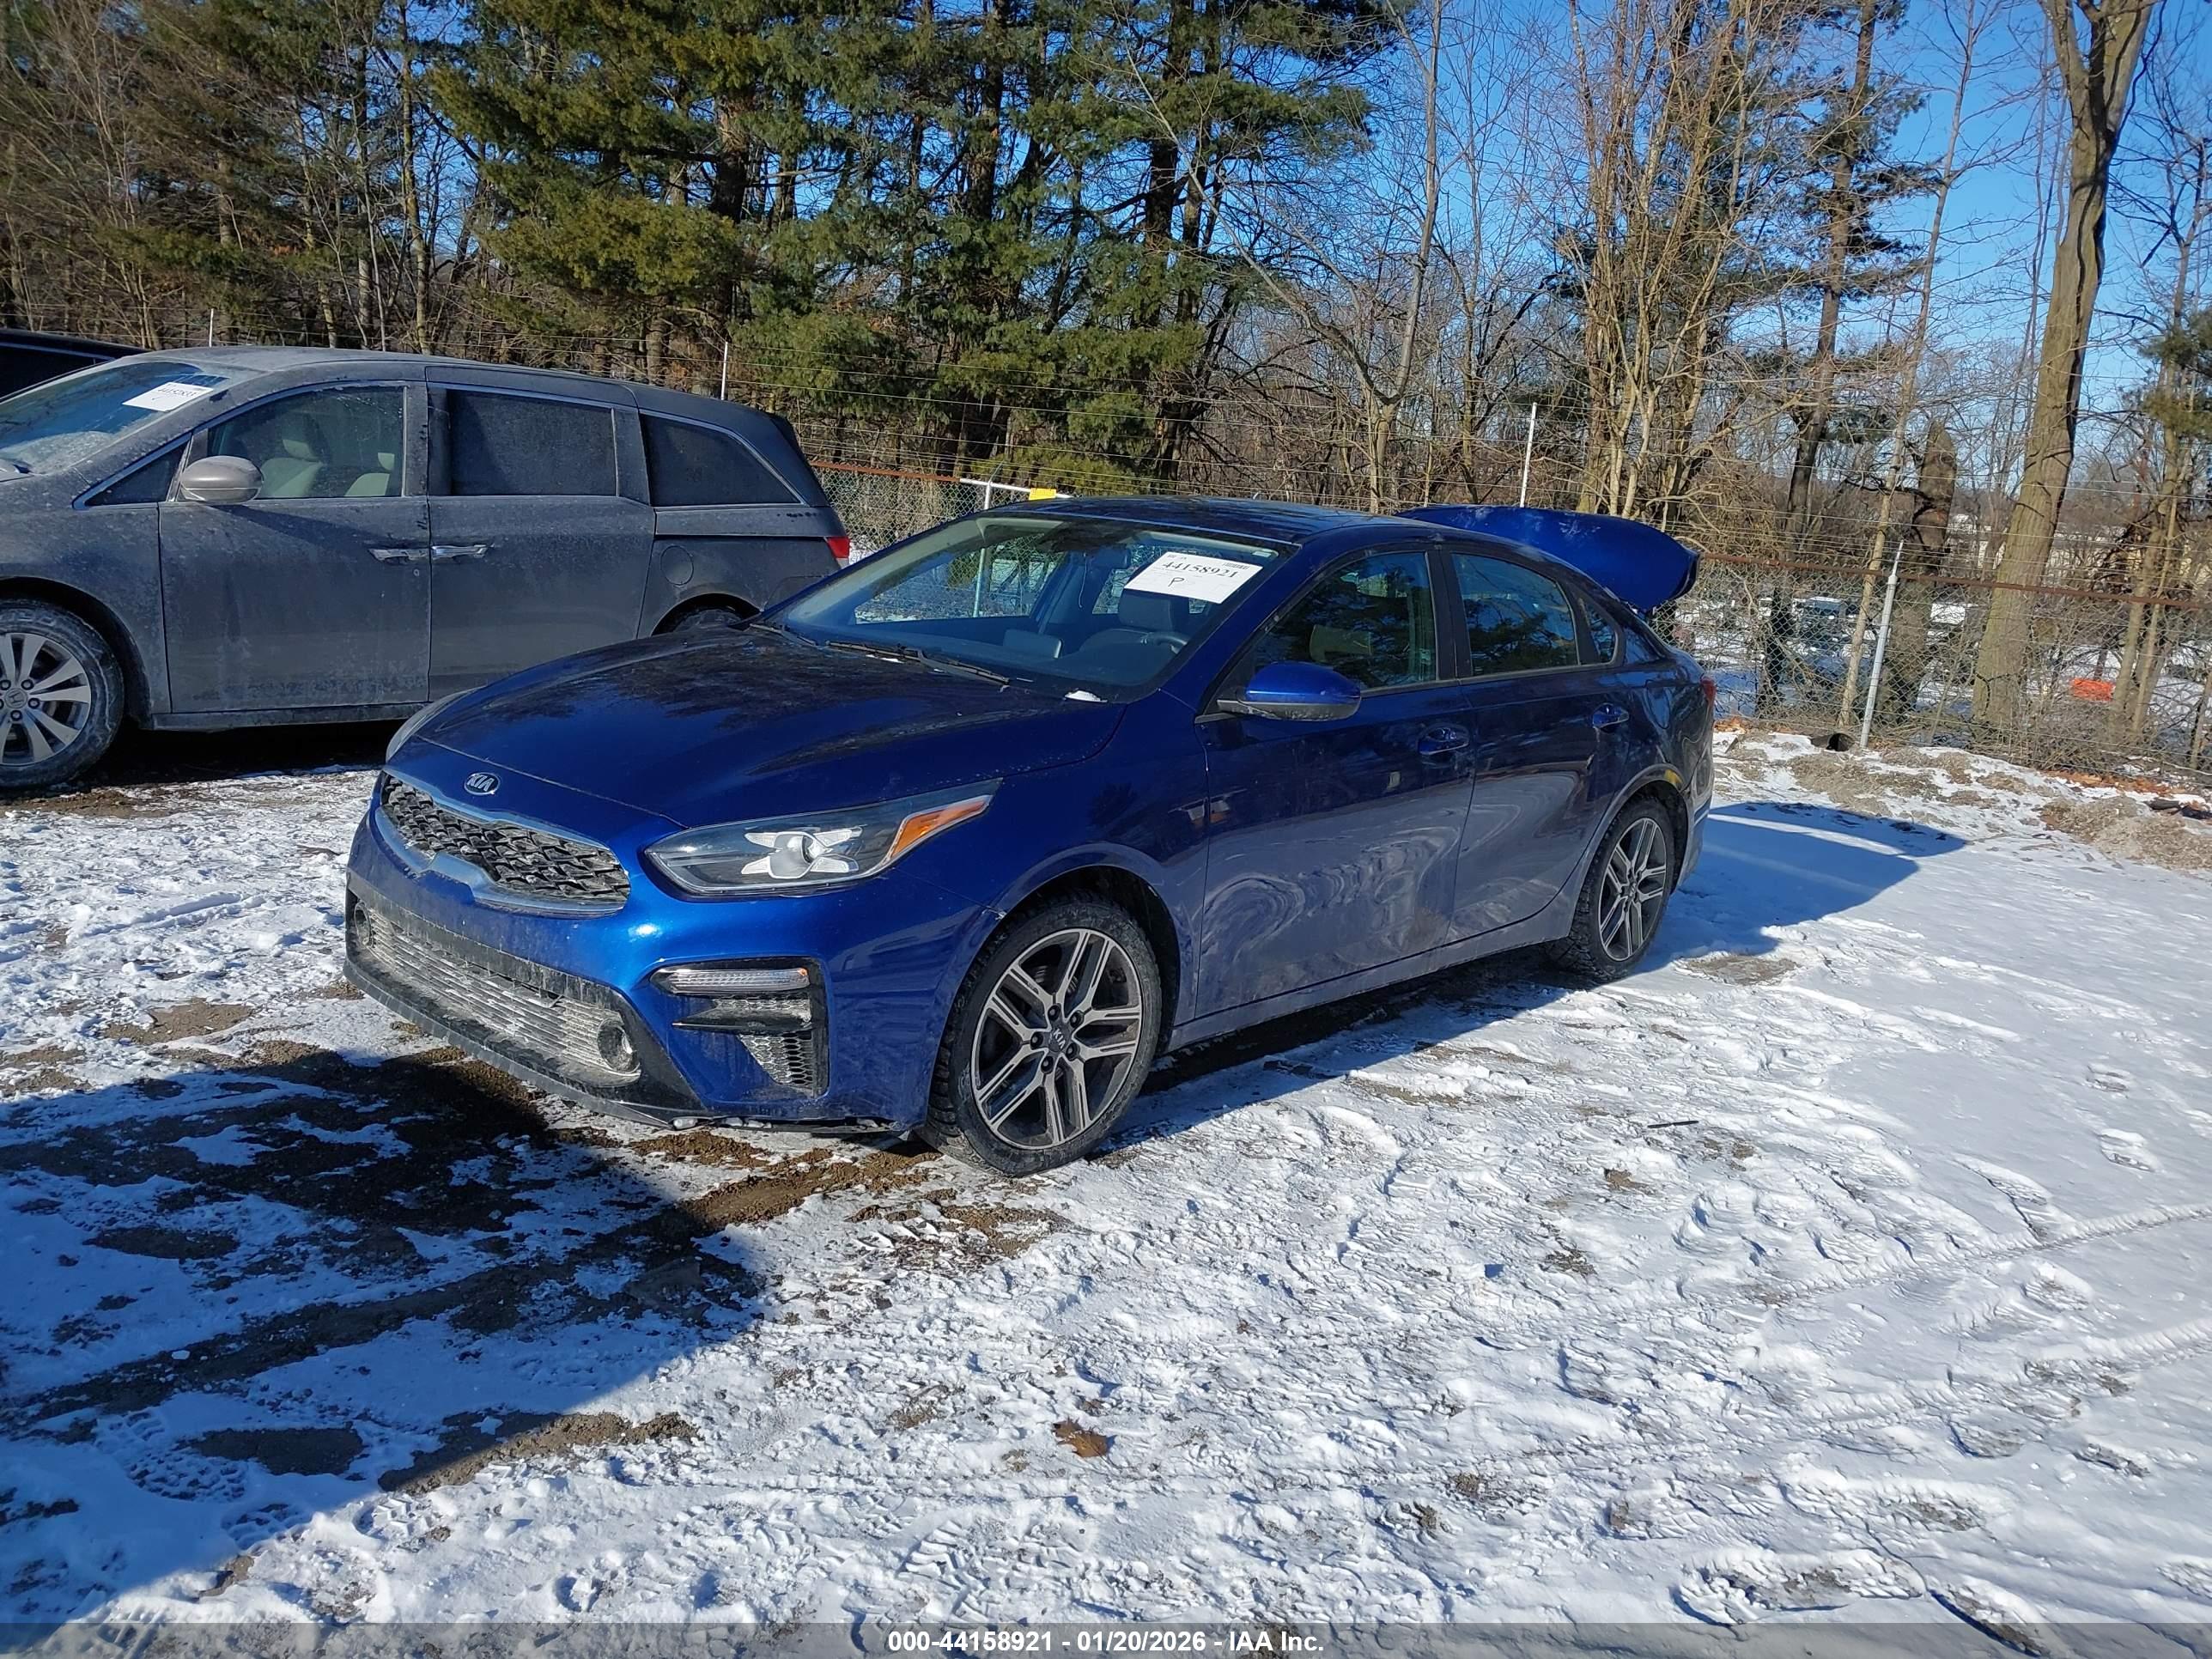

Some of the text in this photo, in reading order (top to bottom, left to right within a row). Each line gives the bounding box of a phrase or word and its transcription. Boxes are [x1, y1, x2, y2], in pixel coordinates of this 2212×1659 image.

[1162, 561, 1238, 578] 44158921
[1167, 576, 1185, 587] P
[466, 773, 495, 792] KIA
[1053, 1028, 1066, 1049] KIA
